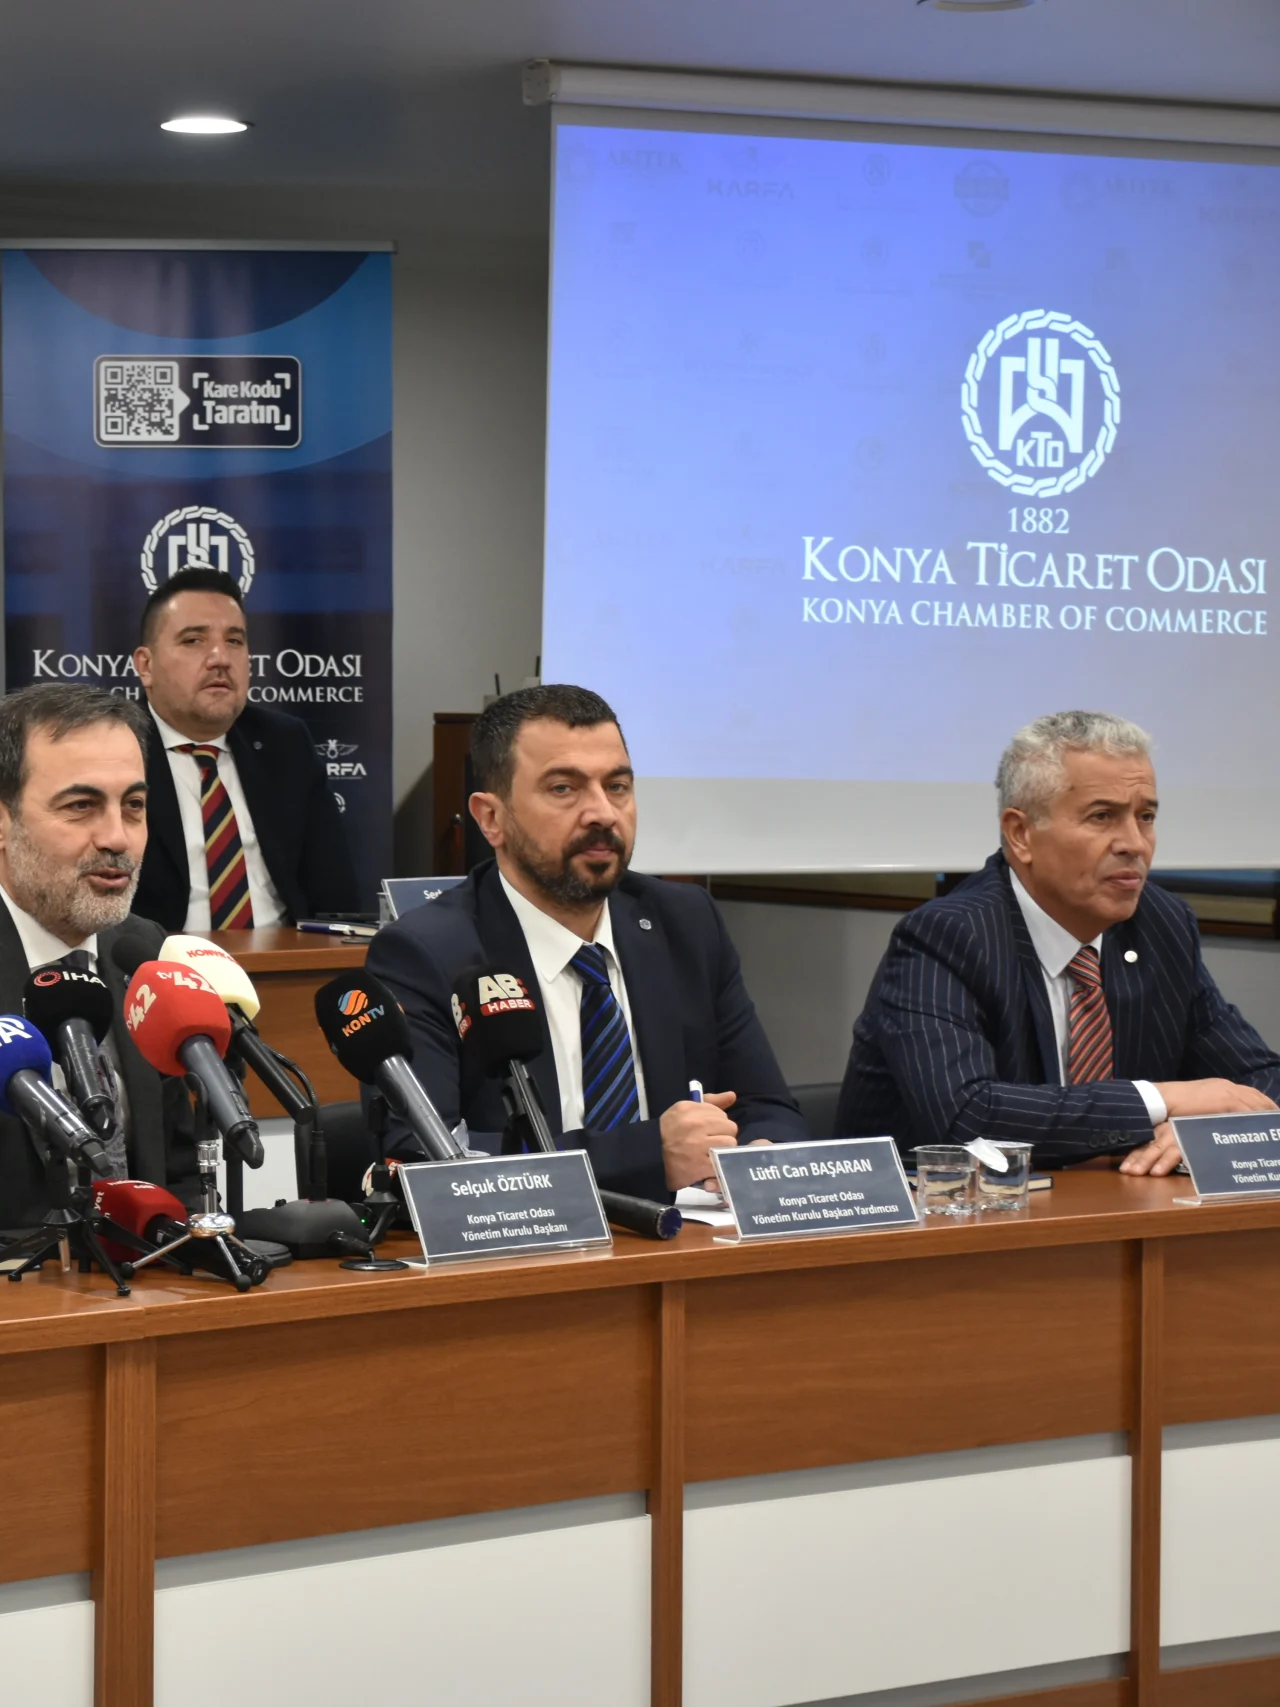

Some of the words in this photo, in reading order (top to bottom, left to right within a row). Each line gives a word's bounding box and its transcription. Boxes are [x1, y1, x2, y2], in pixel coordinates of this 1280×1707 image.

[203, 380, 239, 399] Kare
[240, 380, 282, 399] Kodu
[203, 400, 281, 425] Taratın
[1016, 430, 1064, 468] KTO
[1007, 507, 1070, 534] 1882
[801, 536, 957, 586] KONYA
[1146, 547, 1268, 594] ODASI
[802, 597, 904, 625] KONYA
[910, 600, 1053, 630] CHAMBER
[1059, 604, 1097, 631] OF
[1105, 606, 1268, 635] COMMERCE
[276, 649, 362, 678] ODASI
[247, 686, 364, 702] COMMERCE
[326, 762, 368, 776] RFA
[424, 889, 442, 900] Ser
[487, 999, 532, 1013] HABER
[1212, 1132, 1269, 1144] Ramazan
[748, 1165, 780, 1181] Lütfi
[782, 1164, 809, 1179] Can
[810, 1158, 872, 1178] BAŞARAN
[1231, 1160, 1258, 1170] Konya
[451, 1178, 496, 1198] Selçuk
[498, 1173, 552, 1192] ÖZTÜRK
[1232, 1173, 1268, 1184] Yönetim
[779, 1196, 808, 1208] Konya
[808, 1193, 840, 1206] Ticaret
[840, 1191, 864, 1202] Odası
[467, 1213, 496, 1226] Konya
[496, 1210, 528, 1222] Ticaret
[530, 1208, 555, 1220] Odası
[752, 1213, 791, 1226] Yönetim
[792, 1210, 822, 1223] Kurulu
[823, 1207, 854, 1222] Başkan
[854, 1204, 899, 1218] Yardımcısı
[462, 1230, 502, 1242] Yönetim
[502, 1226, 533, 1239] Kurulu
[534, 1223, 568, 1238] Başkanı
